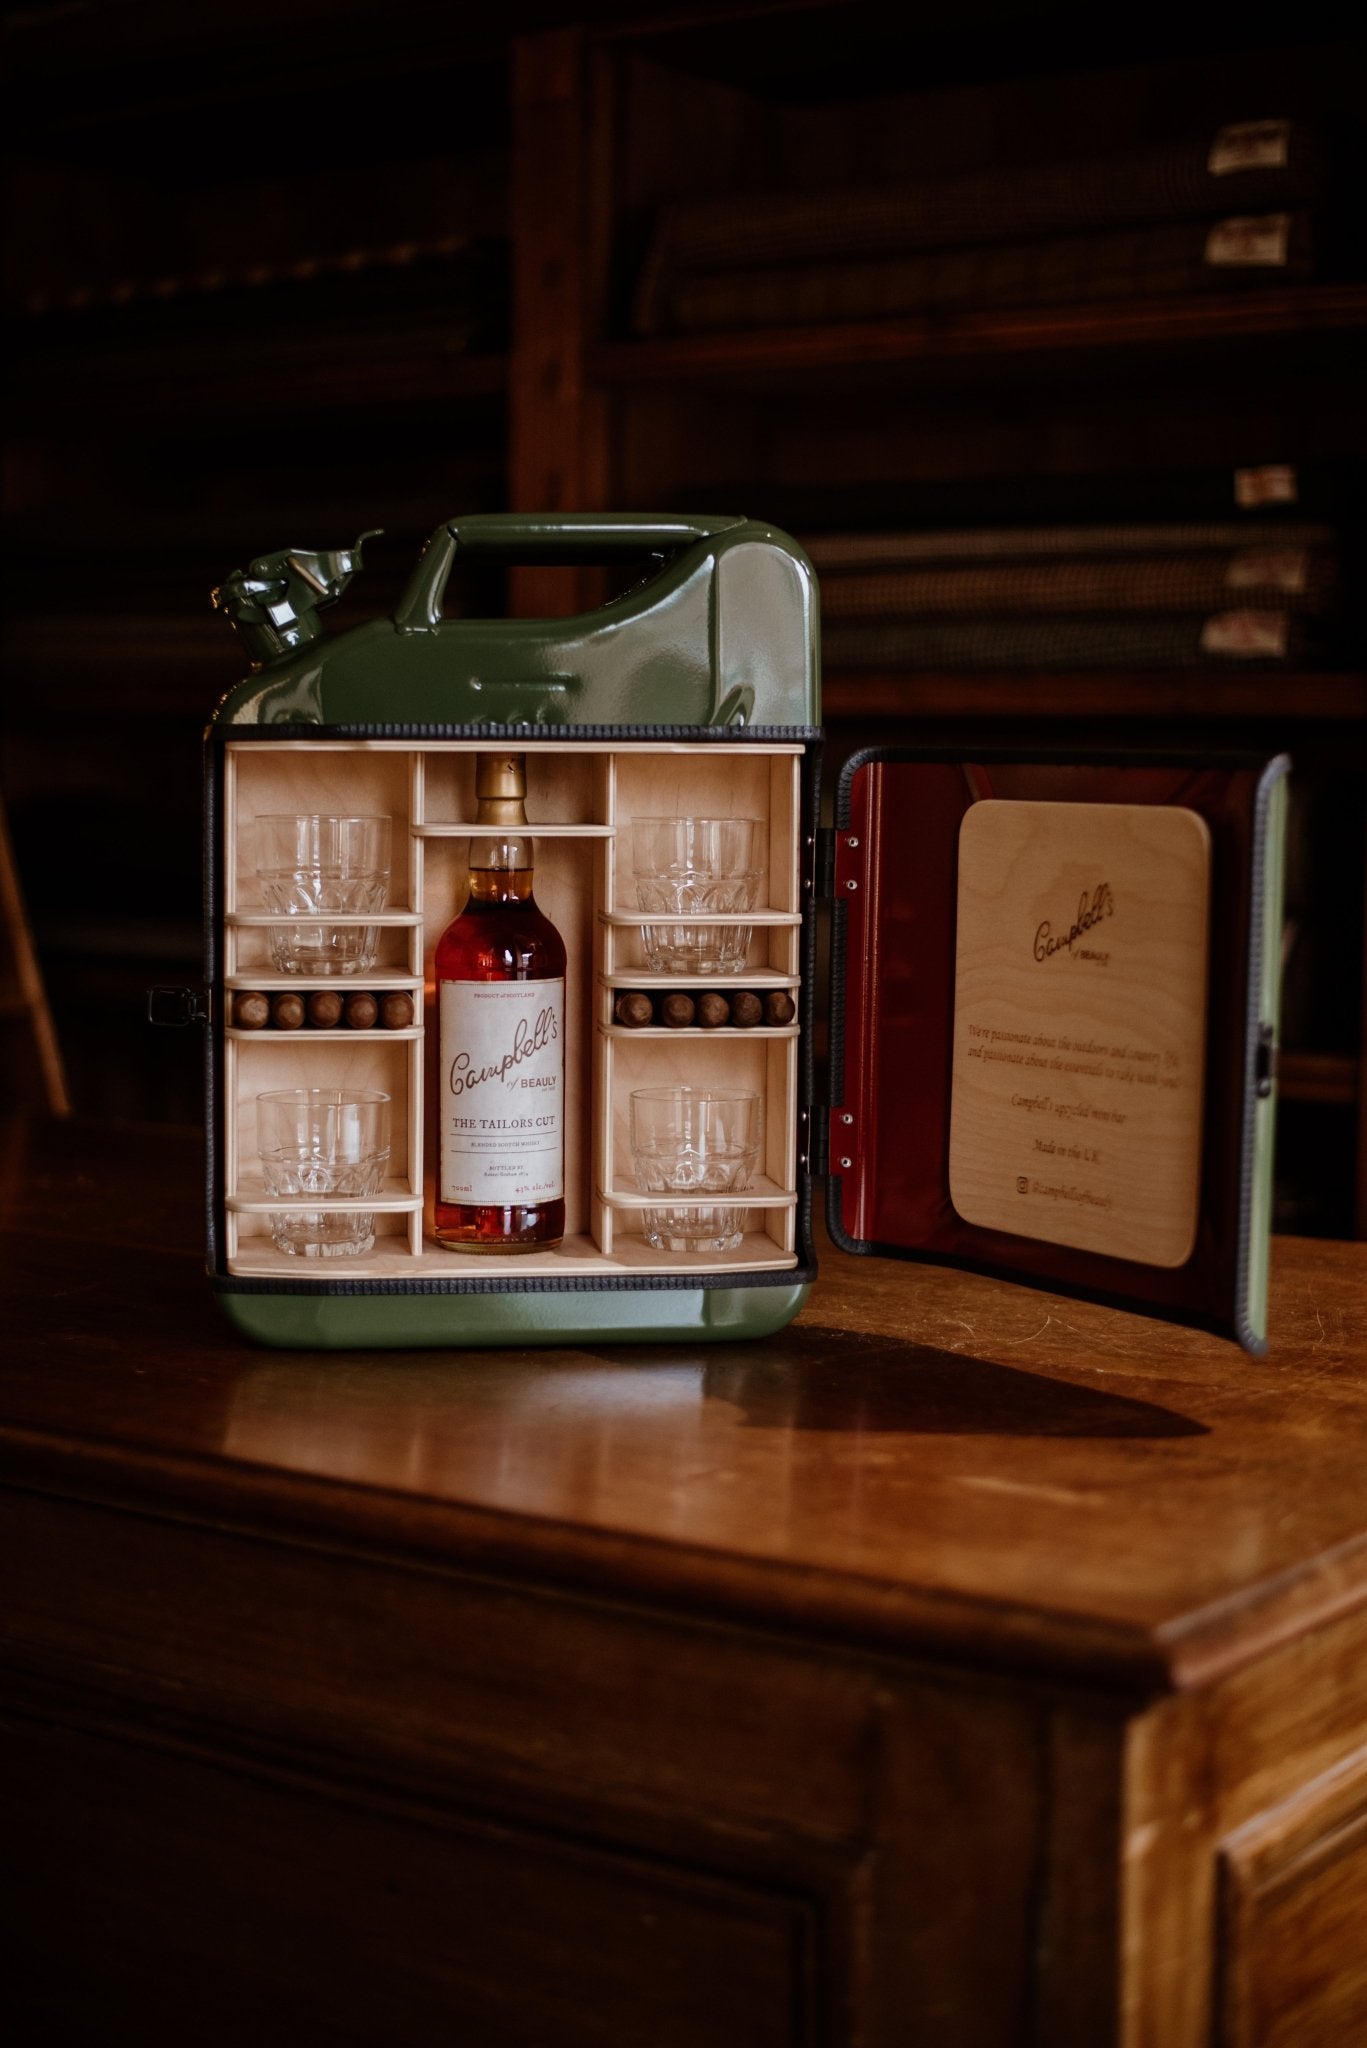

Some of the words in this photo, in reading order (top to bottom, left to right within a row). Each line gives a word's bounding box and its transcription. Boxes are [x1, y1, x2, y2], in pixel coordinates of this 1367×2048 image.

[1033, 883, 1114, 962] Campbell's
[450, 1006, 557, 1095] Campbell's
[521, 1076, 557, 1088] BEAULY
[453, 1118, 477, 1128] THE
[480, 1119, 533, 1129] TAILORS
[536, 1116, 555, 1126] CUT
